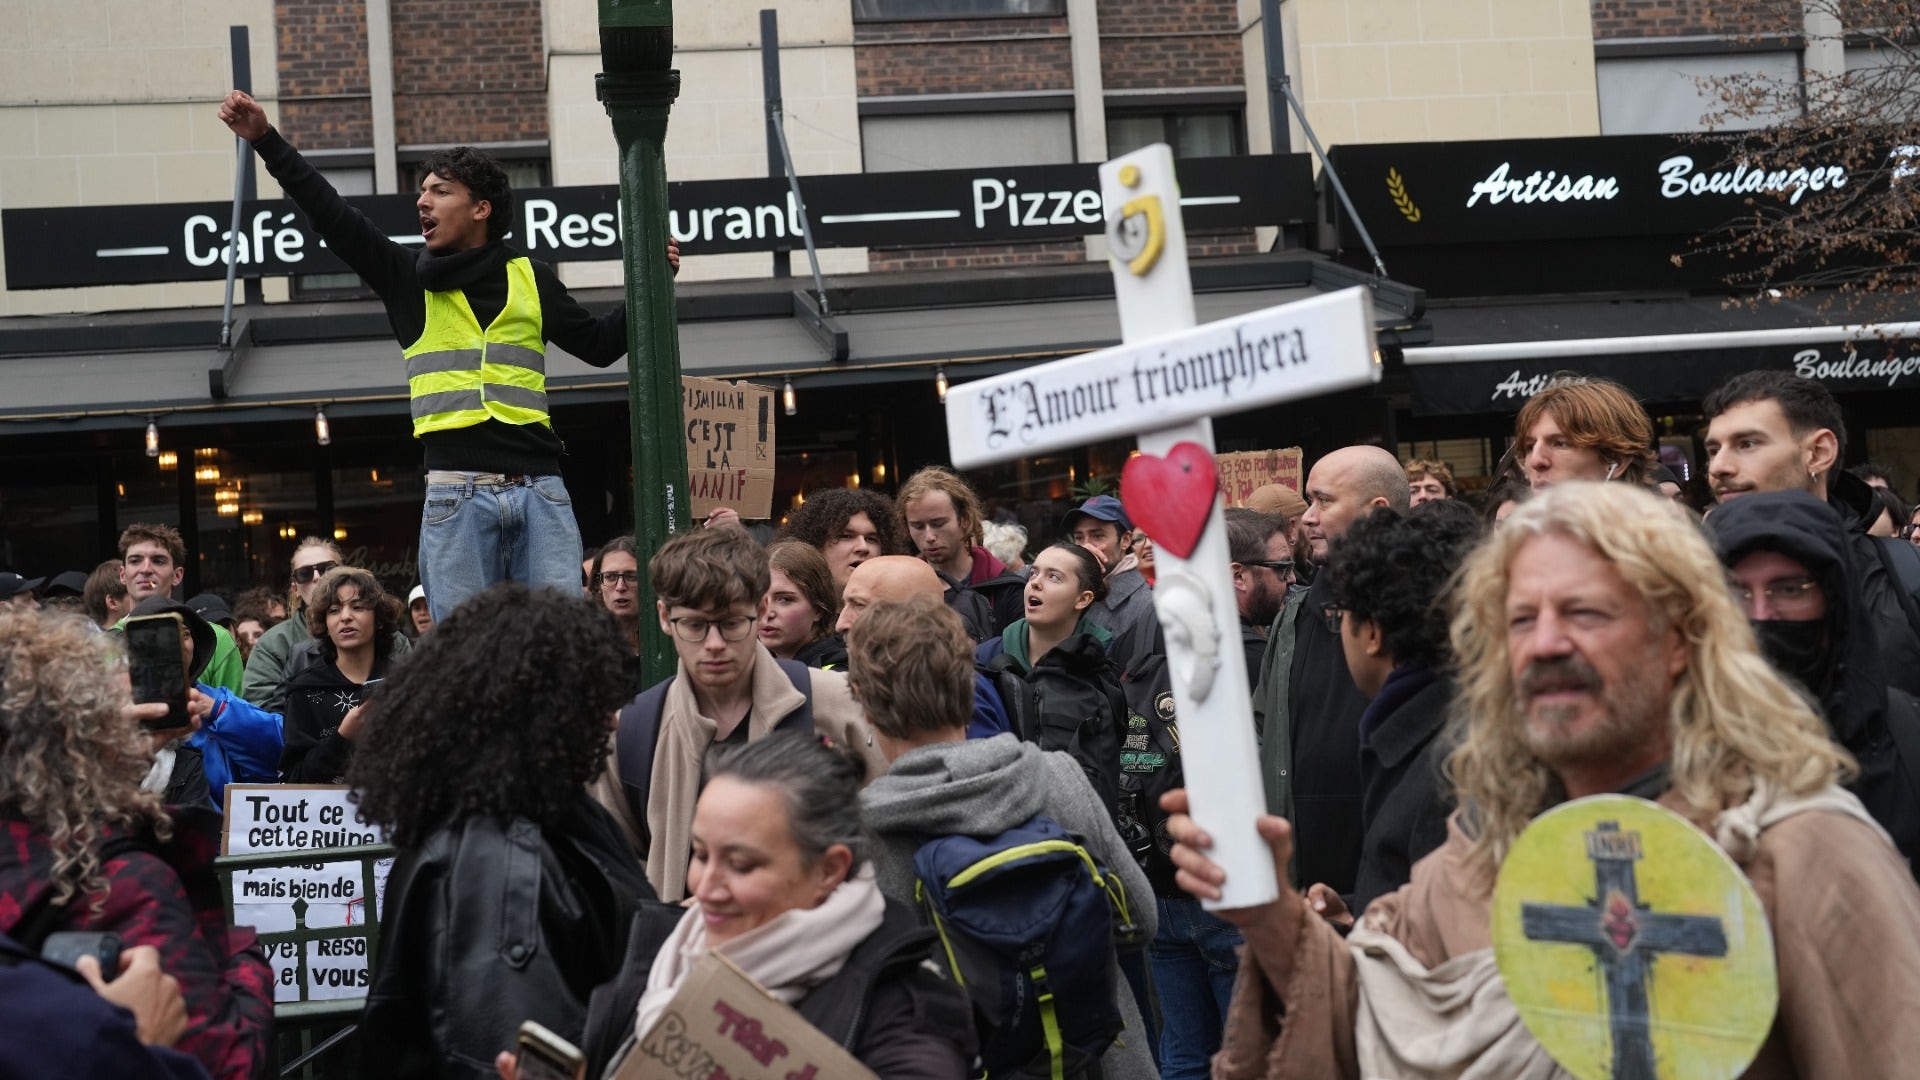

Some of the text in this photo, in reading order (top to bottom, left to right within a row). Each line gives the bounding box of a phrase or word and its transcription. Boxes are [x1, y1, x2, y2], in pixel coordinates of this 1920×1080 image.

[1466, 162, 1619, 208] Artisan
[1658, 155, 1848, 206] Boulanger
[184, 178, 1102, 267] Café Resurant Pizze
[1131, 325, 1309, 404] triomphera
[688, 418, 736, 452] C'EST
[707, 449, 730, 470] LA
[246, 796, 343, 825] Tout ce
[243, 877, 286, 897] mais
[318, 938, 365, 956] Reso
[312, 966, 369, 988] vous
